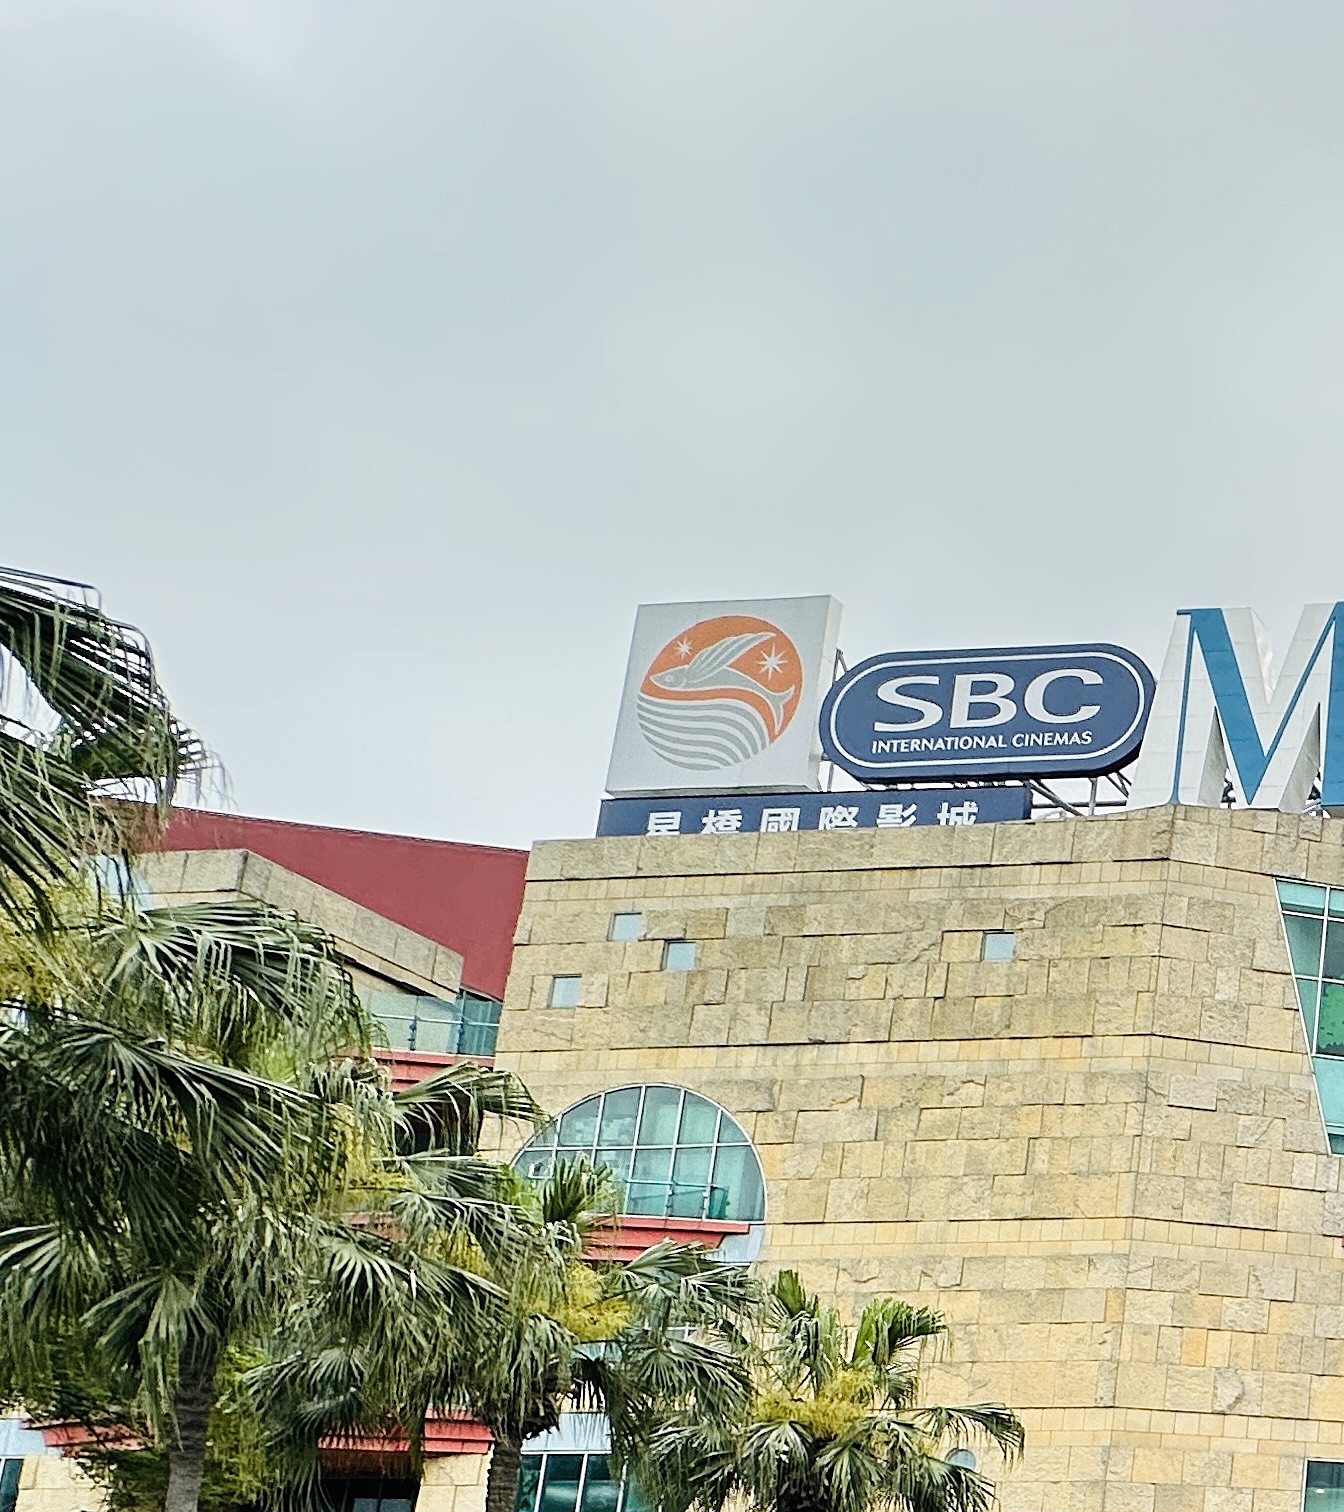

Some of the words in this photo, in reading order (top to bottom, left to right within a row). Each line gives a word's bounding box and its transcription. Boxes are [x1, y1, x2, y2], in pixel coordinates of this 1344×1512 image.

[873, 667, 1105, 733] SBC
[871, 733, 1007, 754] INTERNATIONAL
[1011, 730, 1093, 748] CINEMAS
